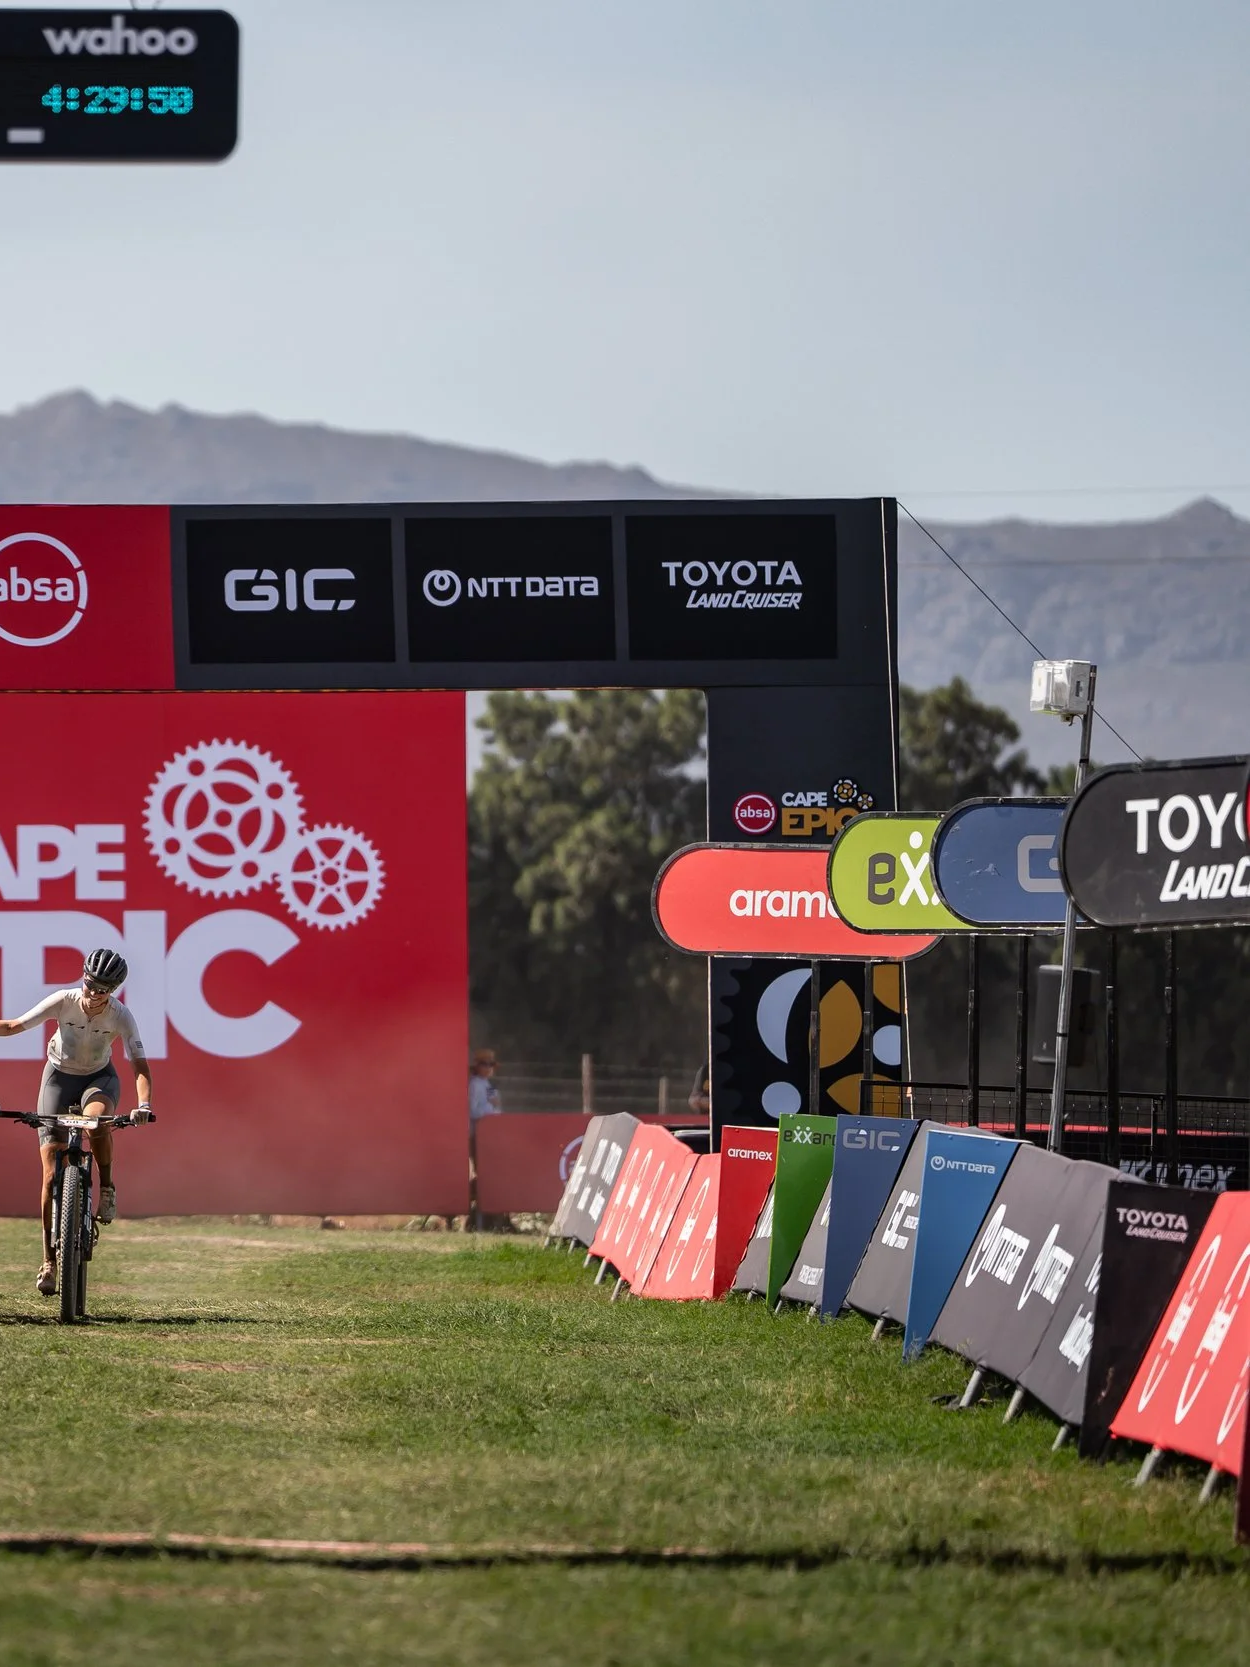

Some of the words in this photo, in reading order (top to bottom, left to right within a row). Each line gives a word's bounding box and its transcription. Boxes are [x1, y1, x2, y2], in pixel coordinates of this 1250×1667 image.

[43, 15, 197, 56] wahoo
[661, 560, 803, 586] TOYOTA
[224, 568, 356, 612] GIC
[468, 577, 522, 597] NTT
[781, 791, 828, 807] CAPE
[739, 807, 771, 819] absa
[1125, 792, 1247, 854] TOY
[729, 889, 840, 919] aram
[842, 1128, 901, 1152] GIC
[727, 1147, 773, 1162] aramex
[947, 1160, 967, 1171] NTT
[1116, 1207, 1189, 1231] TOYOTA
